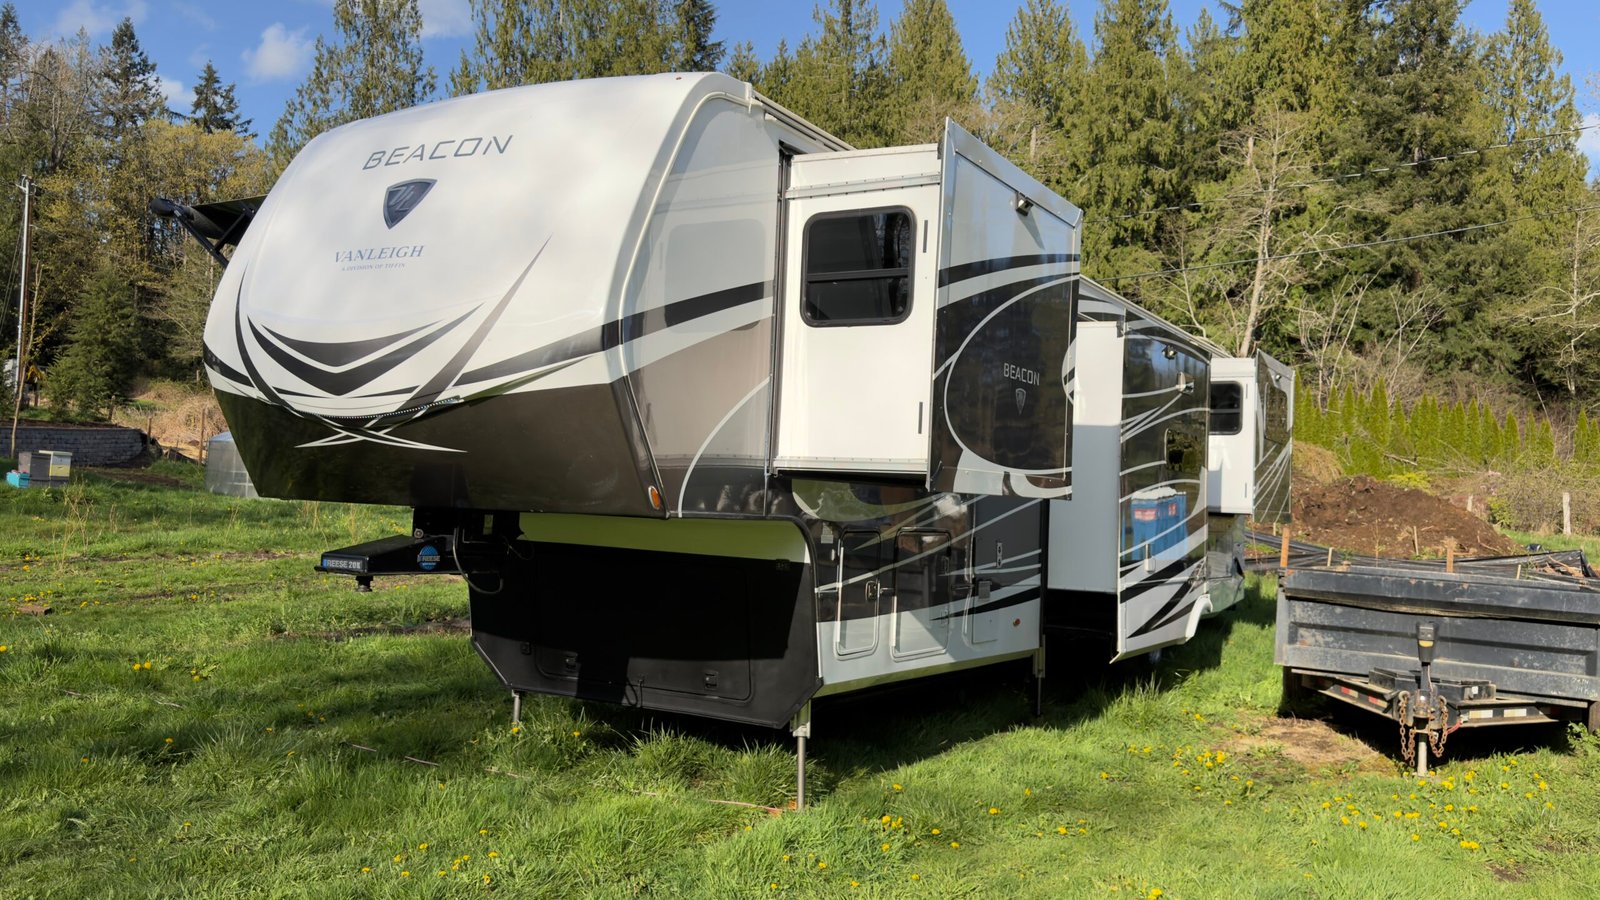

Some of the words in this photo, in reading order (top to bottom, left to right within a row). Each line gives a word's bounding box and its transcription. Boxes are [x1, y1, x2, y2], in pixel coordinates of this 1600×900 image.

[362, 135, 513, 170] BEACON
[335, 245, 424, 262] VANLEIGH
[1003, 362, 1040, 386] BEACON
[327, 559, 348, 568] REESE
